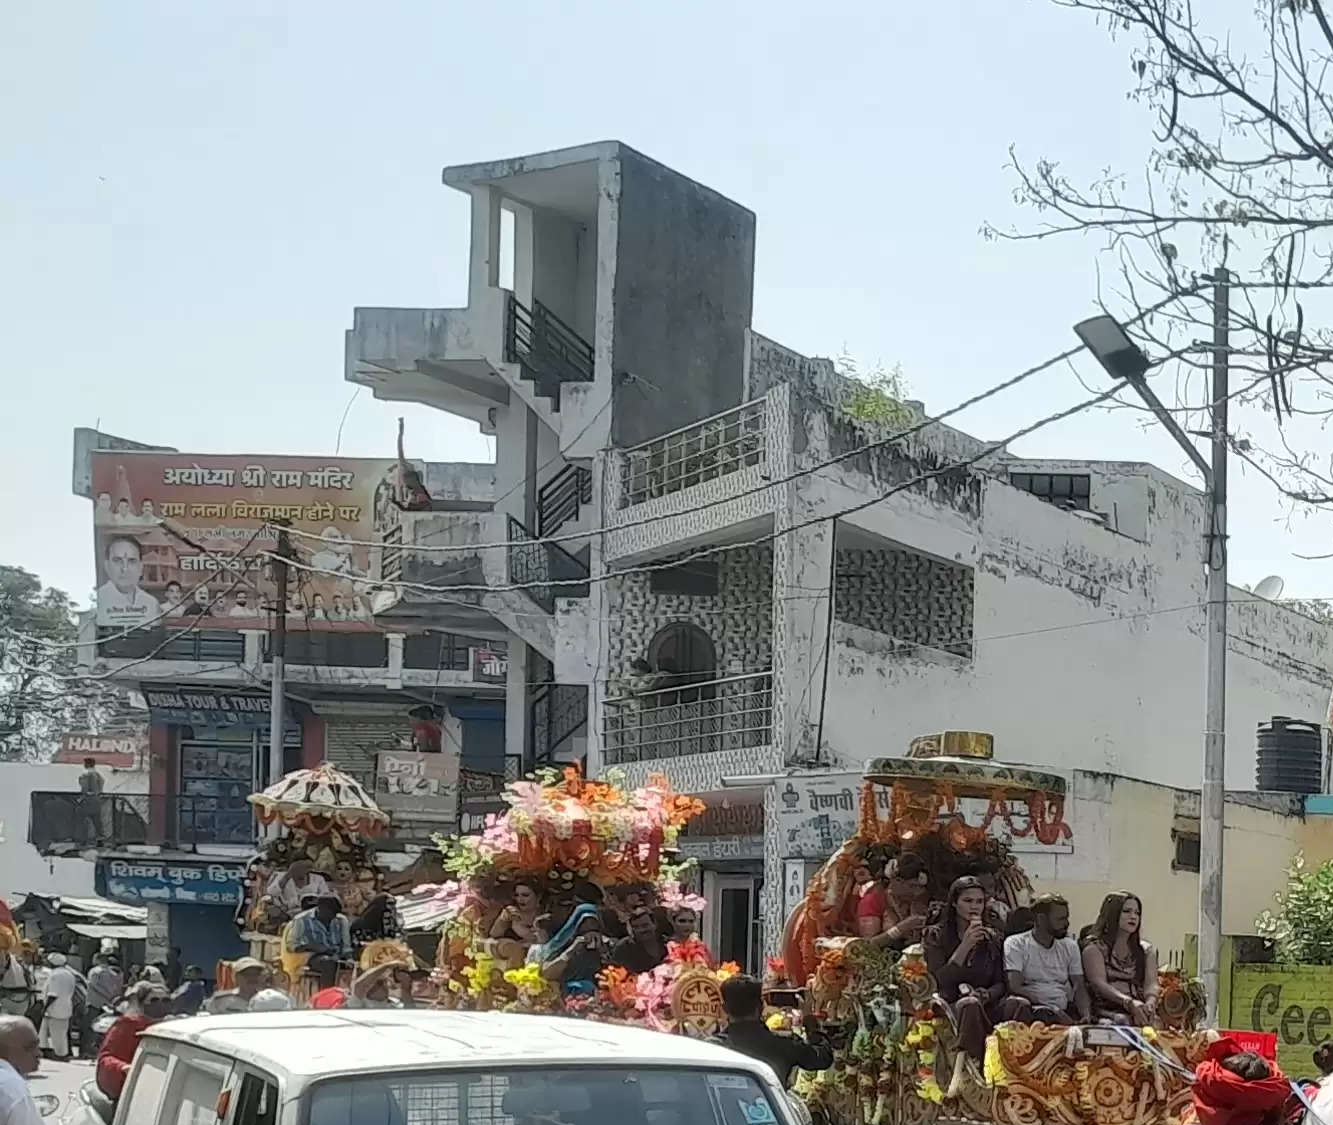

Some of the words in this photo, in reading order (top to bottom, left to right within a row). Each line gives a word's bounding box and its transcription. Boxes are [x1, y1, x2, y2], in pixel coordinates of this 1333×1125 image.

[163, 463, 234, 486] अयोध्या
[241, 465, 270, 488] श्री
[271, 471, 303, 488] राम
[308, 467, 354, 490] मंदिर
[160, 502, 185, 517] राम
[190, 503, 226, 517] लला
[339, 506, 360, 521] पर
[232, 695, 272, 712] TRAVE
[1252, 983, 1332, 1046] Cee
